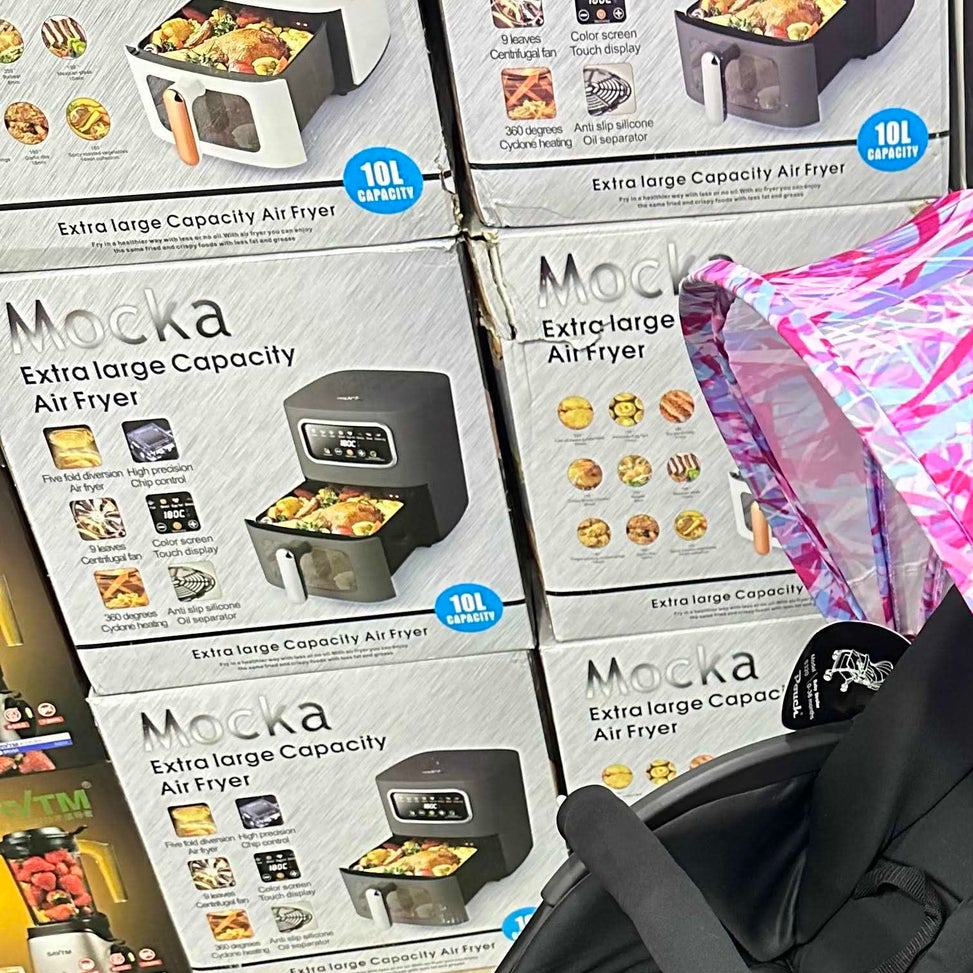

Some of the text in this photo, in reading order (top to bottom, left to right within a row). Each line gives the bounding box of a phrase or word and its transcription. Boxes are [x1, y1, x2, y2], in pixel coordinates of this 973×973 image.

[501, 34, 542, 45] 9 leaves
[570, 30, 638, 42] Color screen
[490, 48, 558, 62] Centrifugal fan
[570, 43, 642, 56] Touch display
[504, 124, 564, 137] 360 degrees
[574, 118, 654, 132] Anti slip silicone
[874, 120, 912, 145] 10L
[500, 137, 572, 150] Cyclone heating
[582, 132, 648, 146] Oil separator
[867, 145, 919, 162] CAPACITY
[360, 159, 404, 187] 10L
[592, 161, 846, 192] Extra large Capacity Air Fryer
[357, 186, 414, 203] CAPACITY
[57, 203, 336, 237] Extra large Capacity Air Fryer
[538, 241, 696, 310] Mock
[5, 287, 233, 356] Mocka
[542, 314, 676, 339] Extra large
[548, 342, 646, 365] Air Fryer
[20, 344, 296, 386] Extra large Capacity
[34, 390, 139, 414] Air Fryer
[42, 469, 124, 484] Five fold diversion
[126, 464, 194, 478] High precision
[70, 482, 105, 494] Air fryer
[130, 475, 187, 489] Chip control
[88, 542, 127, 553] 9 leaves
[152, 535, 214, 548] Color screen
[80, 552, 143, 567] Centrifugal fan
[154, 546, 218, 559] Touch display
[448, 592, 486, 613] 10L
[651, 582, 804, 609] Extra large Capacity
[104, 610, 158, 622] 360 degrees
[167, 601, 242, 616] Anti slip silicone
[176, 612, 238, 626] Oil separator
[446, 612, 495, 626] CAPACITY
[101, 620, 168, 634] Cyclone heating
[192, 626, 429, 660] Extra large Capacity Air Fryer
[584, 645, 760, 700] Mocka
[588, 687, 786, 722] Extra large Capaci
[140, 694, 333, 752] Mocka
[594, 721, 678, 742] Air Fryer
[150, 734, 387, 775] Extra large Capacity
[160, 774, 251, 796] Air Fryer
[238, 828, 296, 842] High precision
[262, 837, 290, 848] control
[184, 838, 199, 848] fold
[258, 881, 312, 894] Color screen
[258, 889, 317, 902] Touch display
[292, 938, 330, 950] separator
[328, 961, 366, 973] large
[370, 950, 437, 968] Capacity
[440, 946, 460, 957] Air
[462, 941, 497, 954] Fryer
